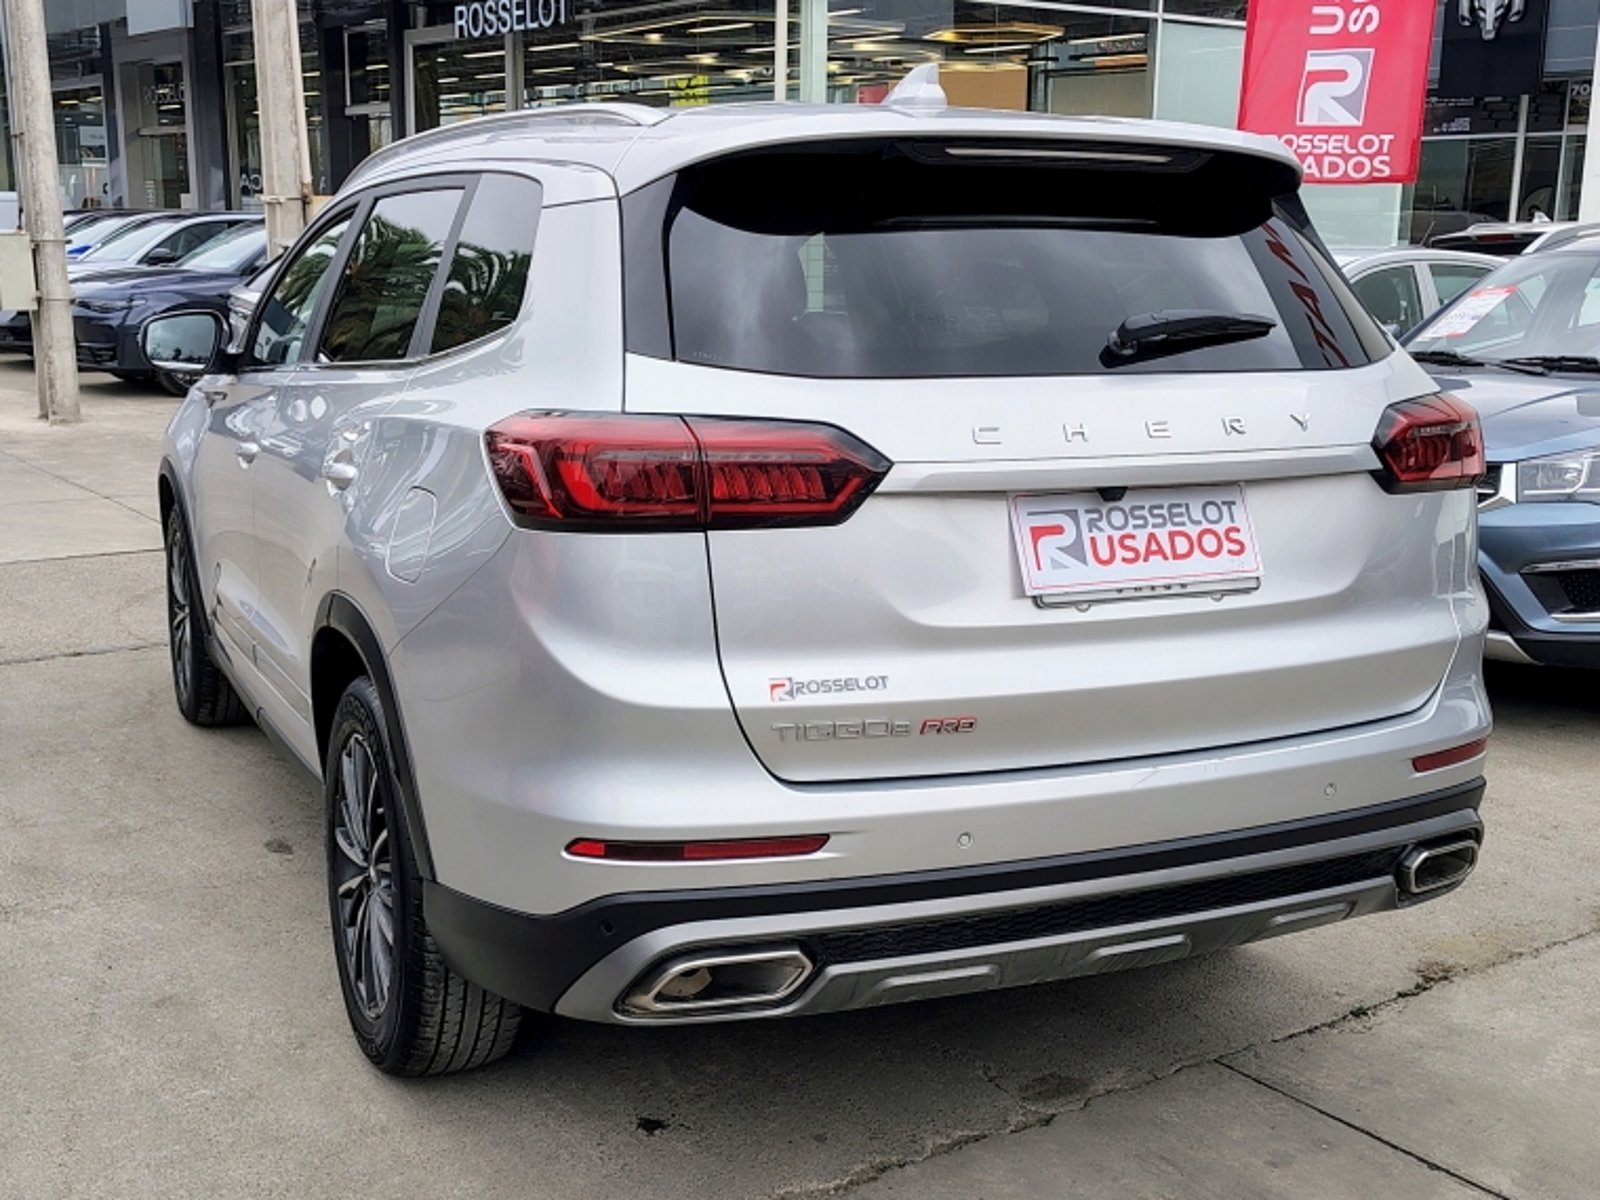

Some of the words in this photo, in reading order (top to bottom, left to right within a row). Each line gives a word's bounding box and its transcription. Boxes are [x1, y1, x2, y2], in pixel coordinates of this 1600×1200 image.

[1302, 155, 1392, 179] ADOS
[972, 412, 1311, 446] CHERY
[1084, 500, 1237, 533] ROSSELOT
[1089, 526, 1246, 567] USADOS
[795, 676, 888, 696] ROSSELOT
